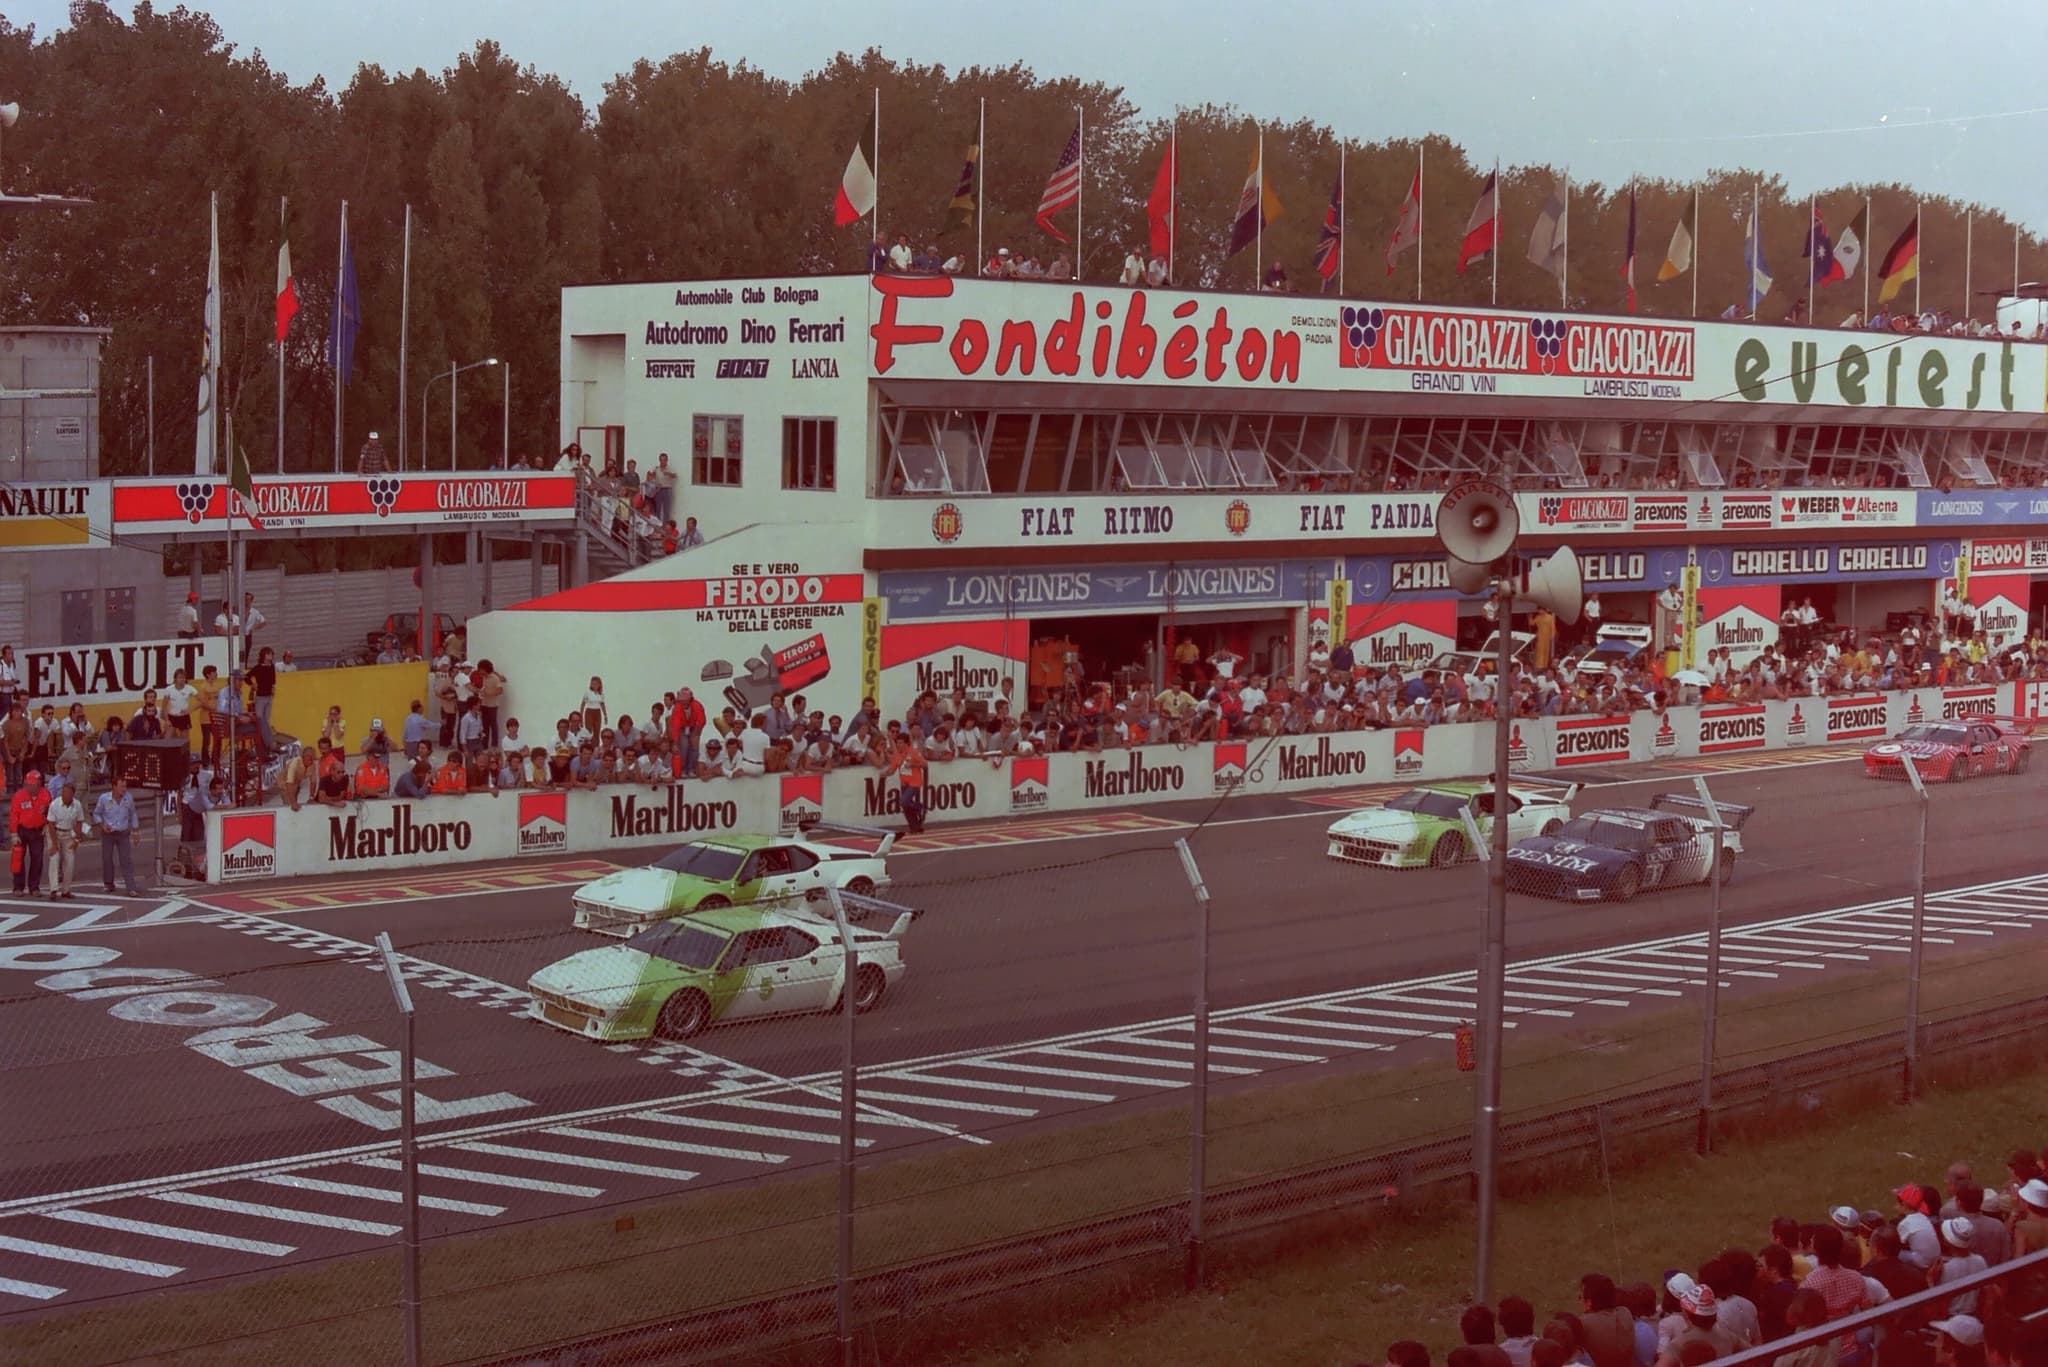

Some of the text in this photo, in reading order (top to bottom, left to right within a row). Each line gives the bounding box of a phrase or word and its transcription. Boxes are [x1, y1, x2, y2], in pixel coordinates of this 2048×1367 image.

[675, 286, 818, 305] Automobile Club Bologna
[645, 317, 844, 345] Autodromo Dino Ferrari
[870, 275, 1301, 383] Fondibéton
[1291, 315, 1338, 329] DEMOLIZIONI
[1305, 333, 1333, 345] PADOVA
[1384, 314, 1693, 377] GIACOBAZZI GIACOBAZZI
[645, 358, 839, 378] Ferrari FIAT LANCIA
[1735, 338, 2014, 411] everest
[1412, 373, 1496, 393] GRANDI VINI
[1584, 380, 1681, 399] LAMBRUSCO MODENA
[231, 481, 527, 515] GCOBAZZI GIACOBAZZI
[1569, 499, 1627, 520] GIACOBAZZI
[1798, 497, 1840, 513] WEBER
[1931, 500, 1983, 516] LONGINES
[260, 518, 305, 527] RANDI VINI
[443, 511, 520, 521] LAMBRUSCO MODENA
[1021, 505, 1174, 536] FIAT RITMO
[1300, 503, 1433, 531] FIAT PANDA
[1634, 503, 1687, 521] arexons
[1722, 503, 1771, 520] arexons
[1732, 546, 1927, 575] CARELLO CARELLO
[1974, 544, 2023, 566] FERODO
[732, 564, 748, 576] SE
[768, 563, 799, 574] VERO
[706, 577, 823, 606] FERODO
[947, 572, 1091, 606] LONGINES
[1147, 566, 1276, 598] LONGINES
[697, 606, 844, 622] HA TUTTA L'ESPERIENZA
[729, 618, 812, 633] DELLE CORSE
[1980, 606, 2017, 630] Marlboro
[1716, 617, 1763, 644] Marlboro
[783, 640, 815, 661] FERODO
[1371, 632, 1434, 662] Marlboro
[916, 655, 998, 691] Marlboro
[1828, 706, 1886, 730] arexons
[1943, 697, 1996, 719] arexons
[1556, 727, 1630, 754] arexons
[1700, 716, 1765, 742] arexons
[1278, 736, 1366, 781] Marlboro
[1084, 752, 1184, 798] Marlboro
[864, 768, 976, 817] Maboro
[1012, 786, 1047, 804] Marlboro
[610, 784, 737, 838] Marlboro
[328, 804, 472, 861] Marlboro
[520, 825, 565, 845] Marlboro
[224, 849, 273, 869] Marlboro
